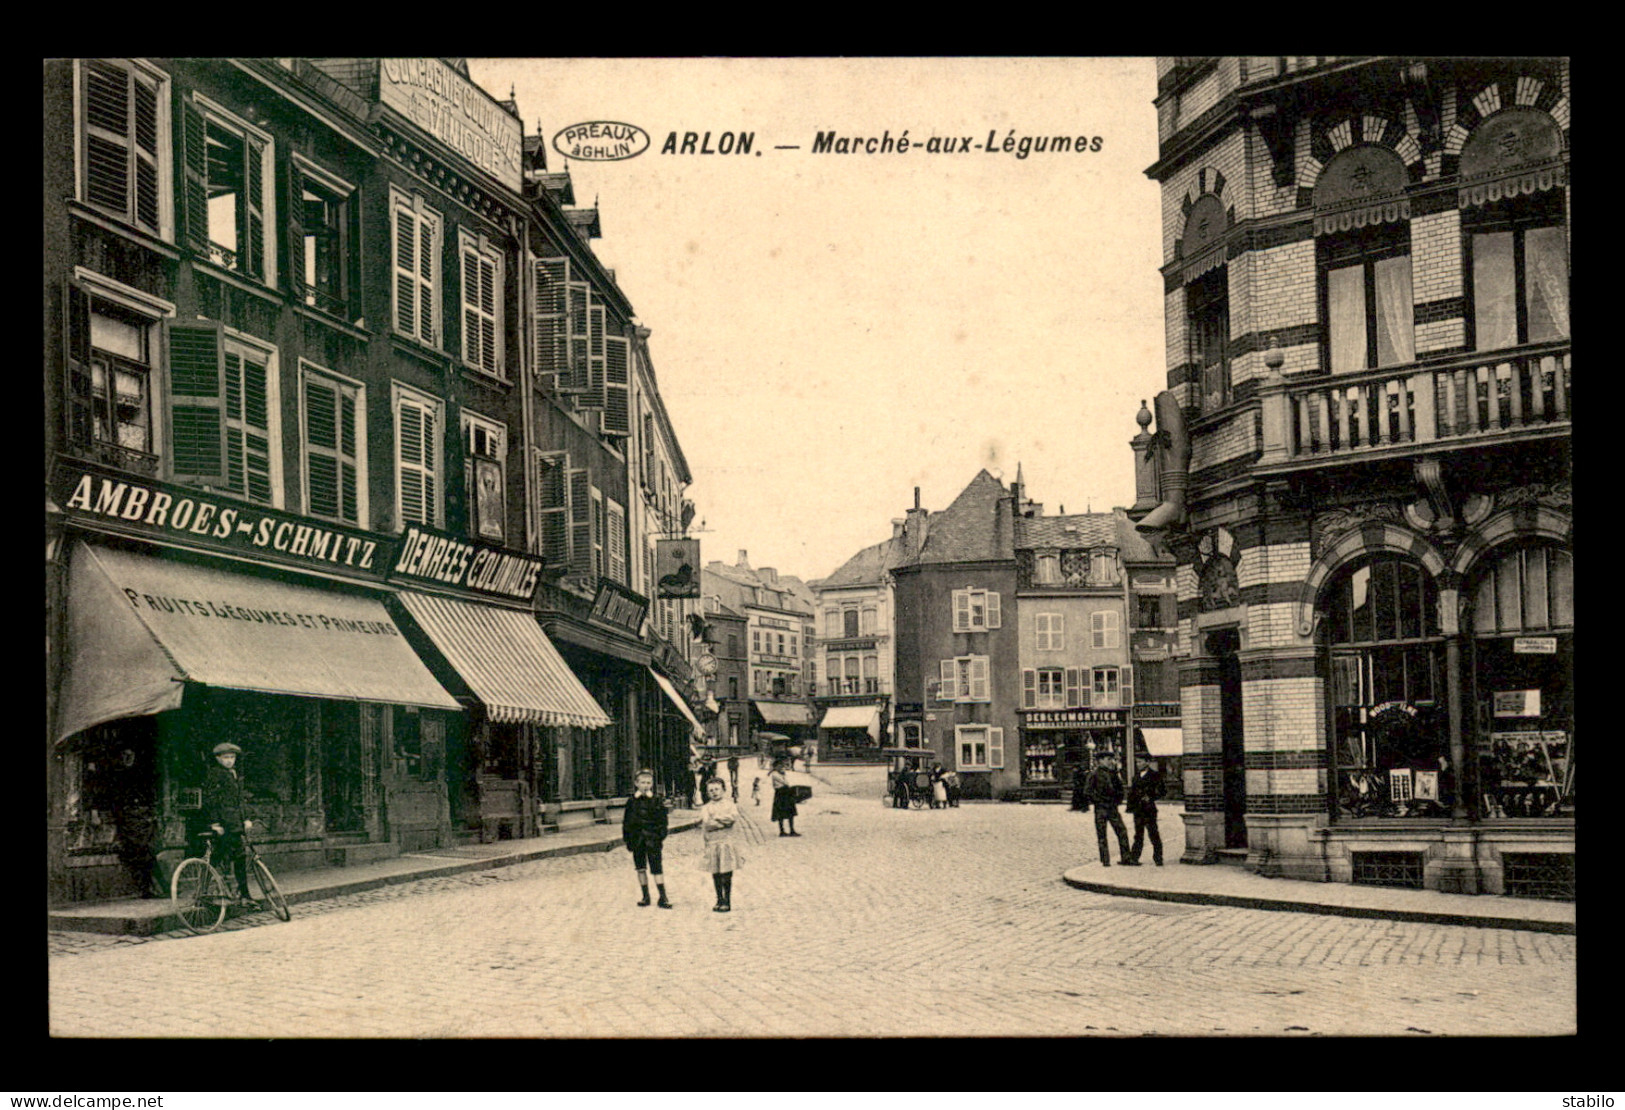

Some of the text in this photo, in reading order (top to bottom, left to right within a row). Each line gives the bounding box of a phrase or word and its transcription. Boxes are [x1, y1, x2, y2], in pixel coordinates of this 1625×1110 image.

[428, 95, 499, 177] VINICOLE
[66, 474, 377, 570] AMBROES-SCHMITZ
[395, 528, 541, 598] DENRÉES COLONIALES
[123, 587, 399, 636] FRUITS LÉGUMES ET PRIMEURS
